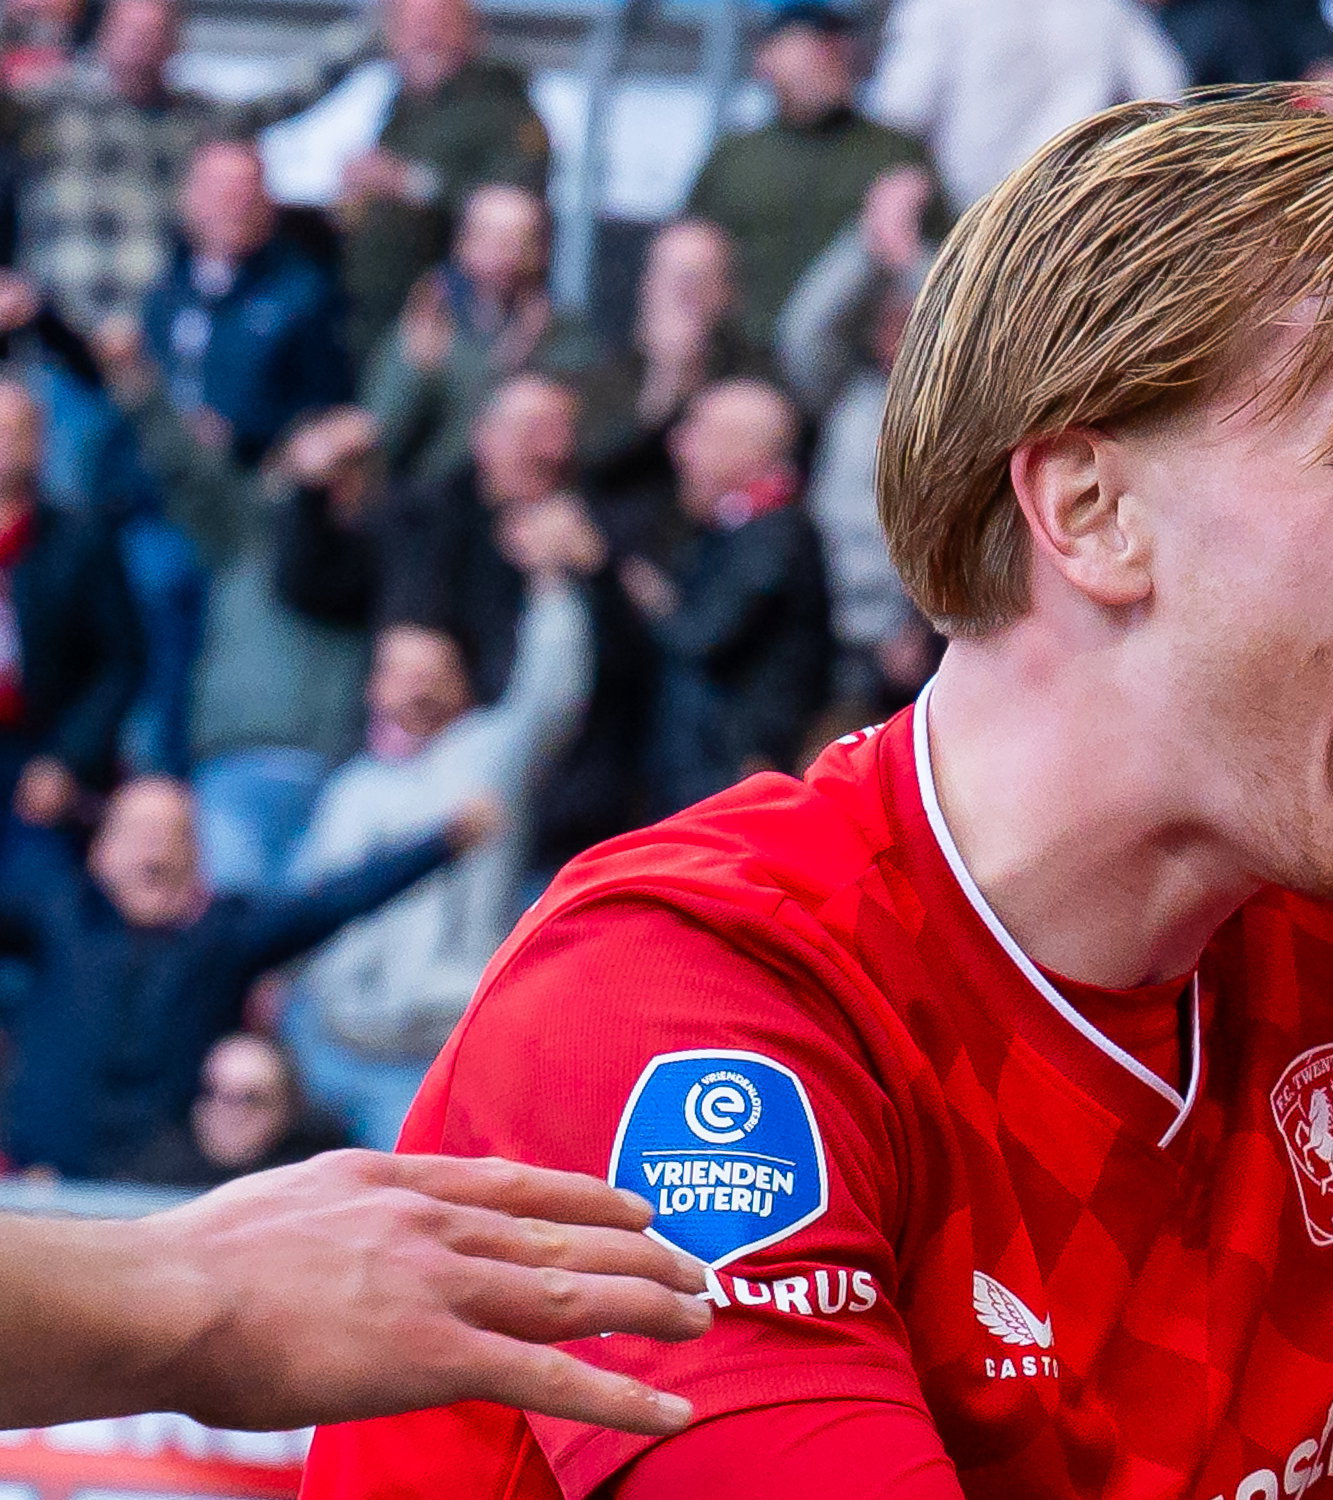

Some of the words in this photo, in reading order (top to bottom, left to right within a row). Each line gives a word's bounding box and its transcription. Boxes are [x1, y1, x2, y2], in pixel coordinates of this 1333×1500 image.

[642, 1160, 795, 1196] VRIENDEN
[657, 1186, 774, 1218] LOTERIJ
[698, 1267, 878, 1316] AURUS
